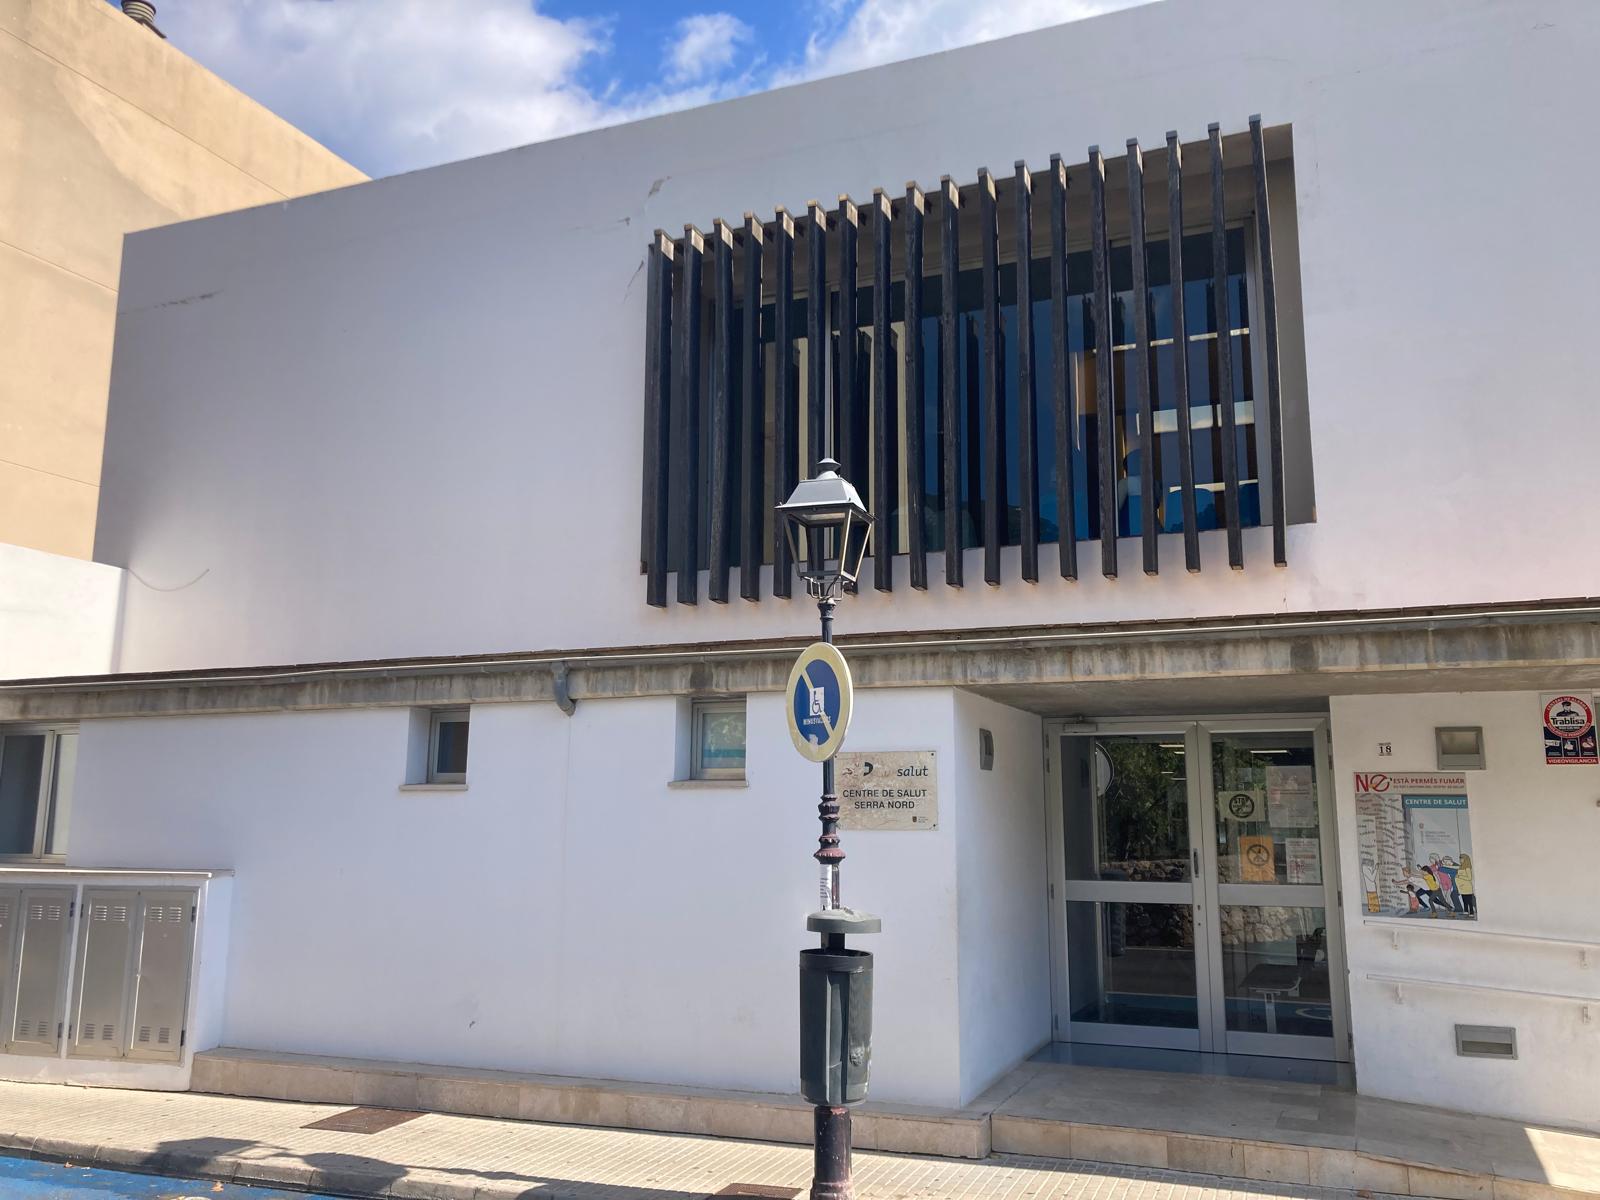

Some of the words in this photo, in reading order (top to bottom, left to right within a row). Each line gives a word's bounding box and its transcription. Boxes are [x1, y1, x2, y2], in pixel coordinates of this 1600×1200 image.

[1550, 716, 1585, 725] Trablisa
[1379, 745, 1392, 754] 18
[897, 765, 928, 777] salut
[842, 789, 880, 798] CENTRE
[881, 789, 895, 798] DE
[896, 789, 928, 798] SALUT
[854, 800, 885, 809] SERRA
[887, 800, 915, 809] NORD
